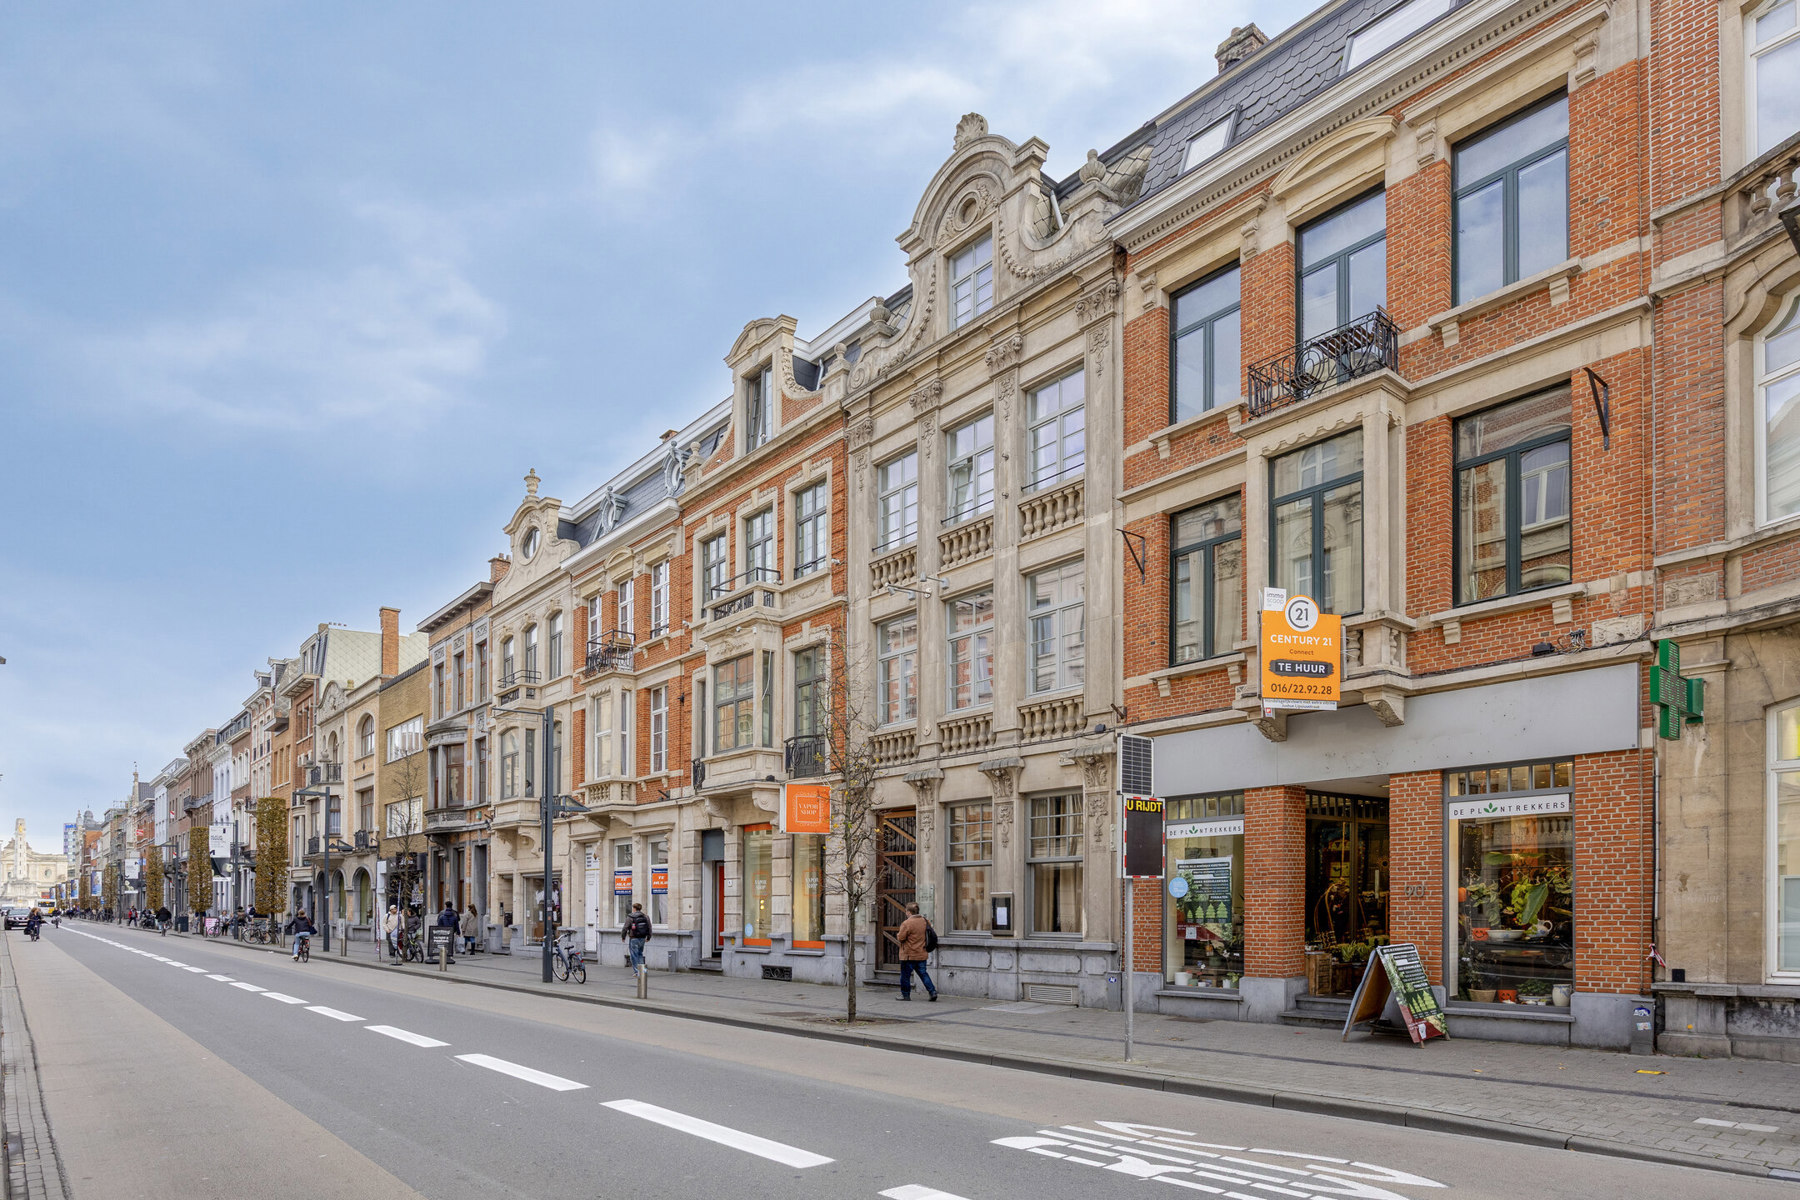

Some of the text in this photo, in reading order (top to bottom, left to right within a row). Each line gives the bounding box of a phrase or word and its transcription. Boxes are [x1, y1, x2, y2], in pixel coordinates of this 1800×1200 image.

[1270, 634, 1332, 646] CENTURY 21
[1289, 648, 1314, 656] Connect
[1278, 662, 1326, 674] TE HUUR
[1270, 683, 1333, 695] 016/22.92.28
[1126, 799, 1163, 812] U RIJDT
[1404, 885, 1425, 898] 90
